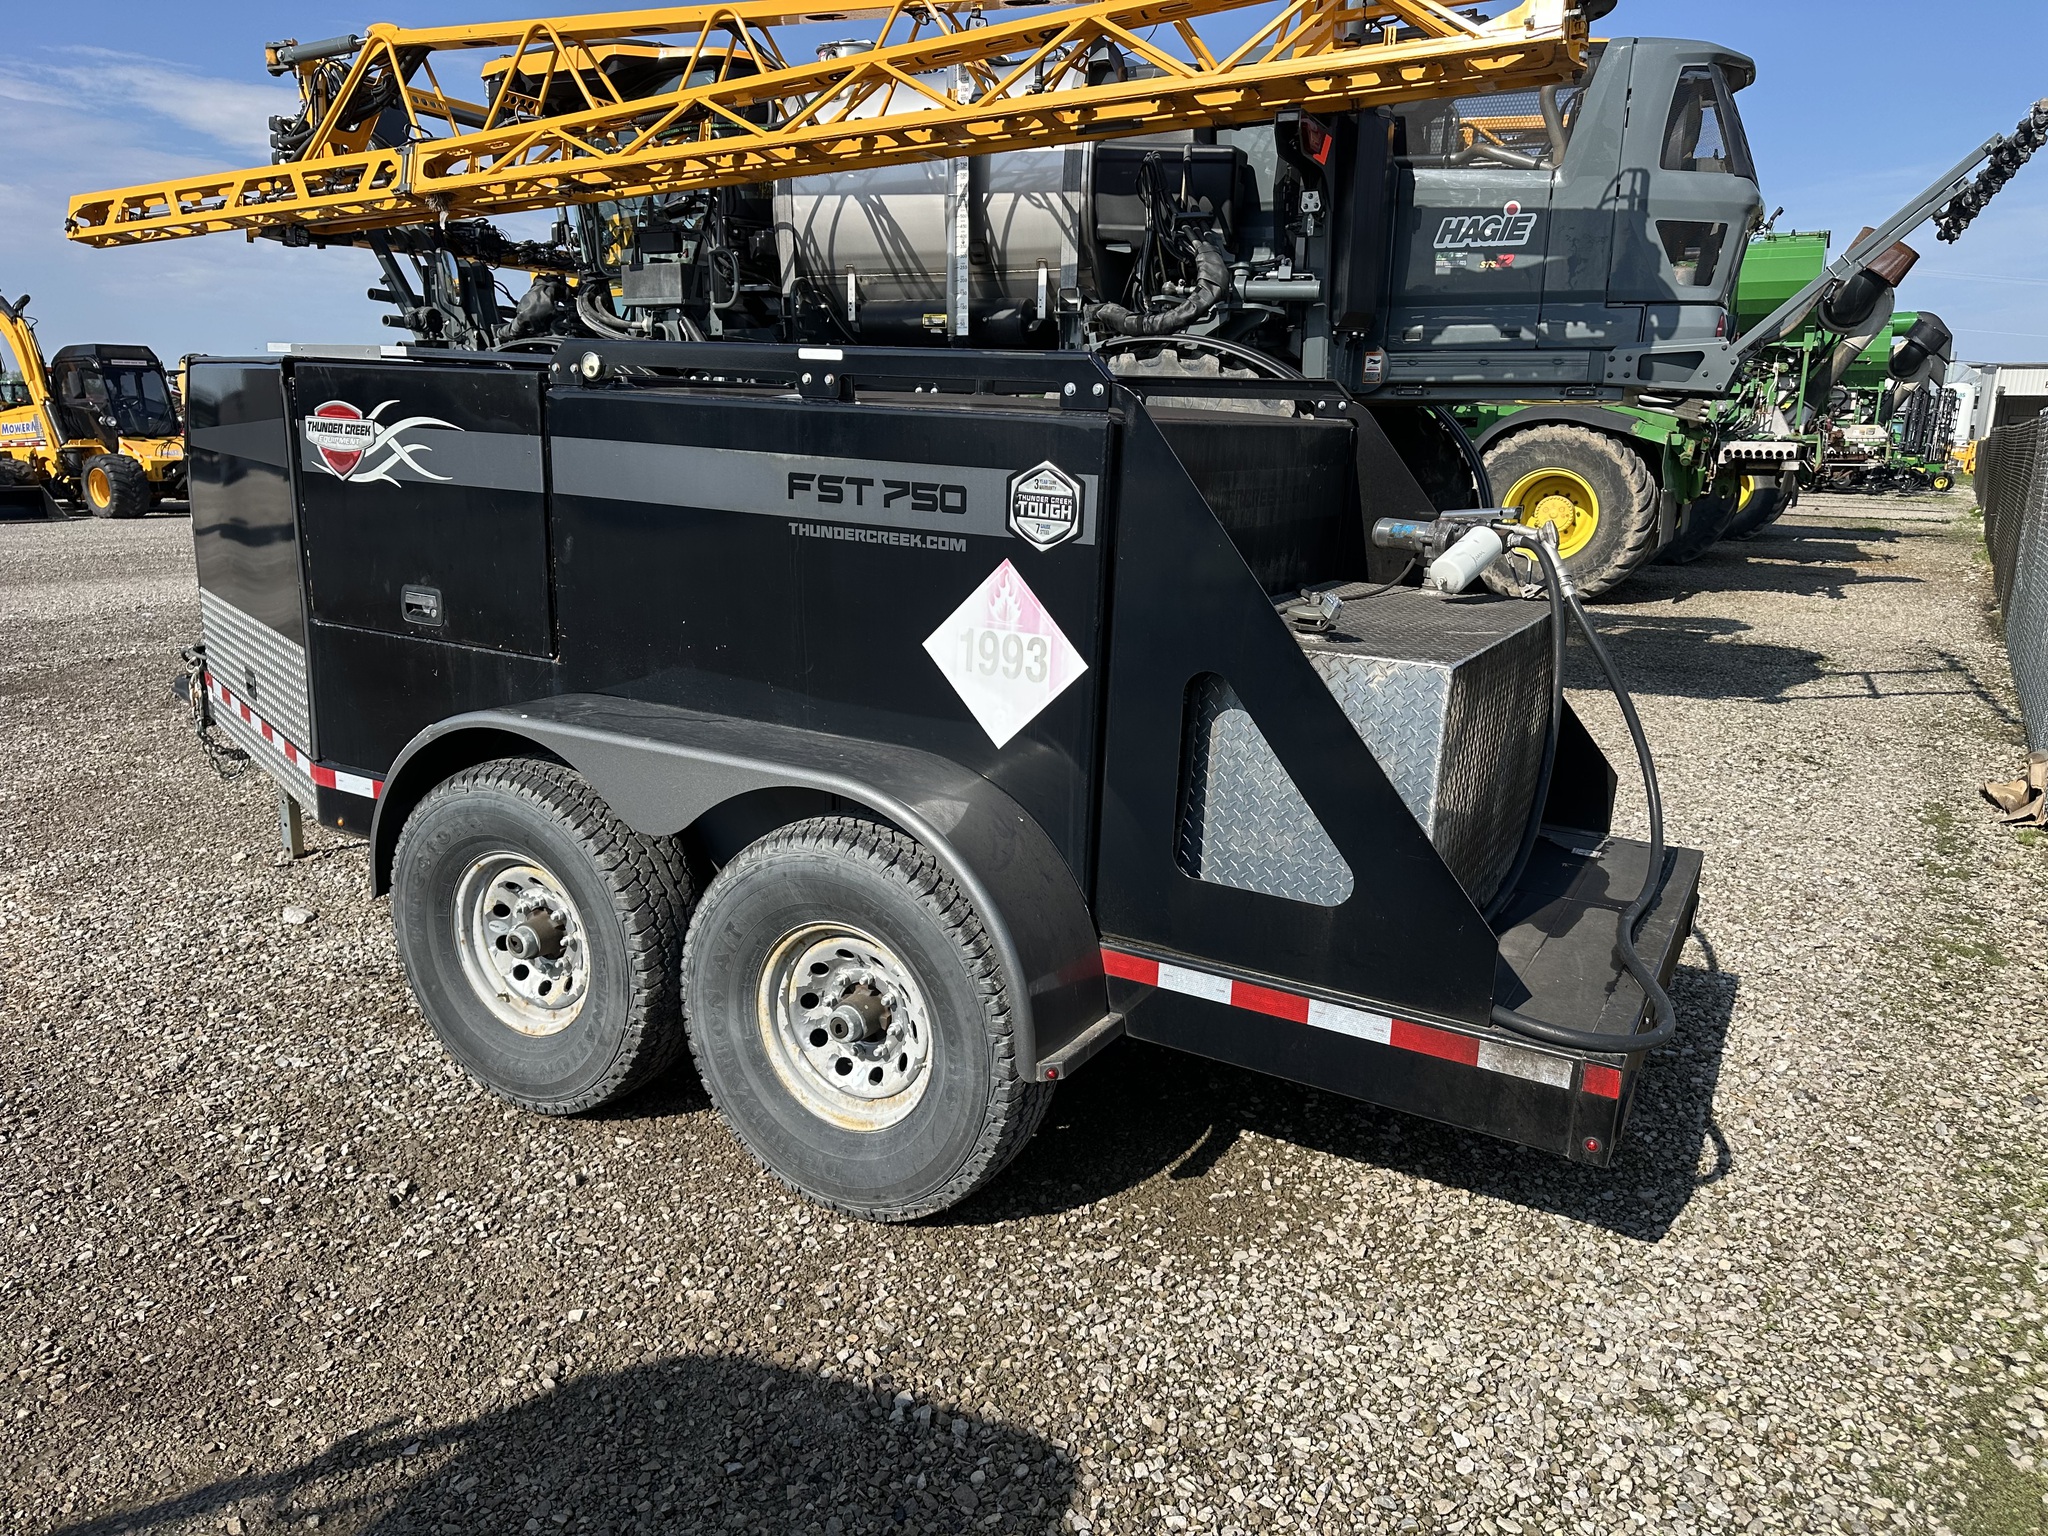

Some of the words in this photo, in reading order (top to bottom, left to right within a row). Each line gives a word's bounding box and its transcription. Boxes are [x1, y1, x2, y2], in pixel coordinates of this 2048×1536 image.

[1433, 201, 1537, 248] HAGIE
[307, 421, 343, 434] THUNDER
[344, 424, 371, 436] CREEK
[318, 435, 360, 446] EQUIPMENT
[788, 472, 874, 505] FST
[881, 479, 967, 515] 750
[1018, 494, 1050, 503] THUNDER
[1051, 497, 1072, 506] CREEK
[1018, 501, 1072, 520] TOUGH
[788, 522, 967, 552] THUNDERCREEK.COM
[960, 627, 1048, 683] 1993
